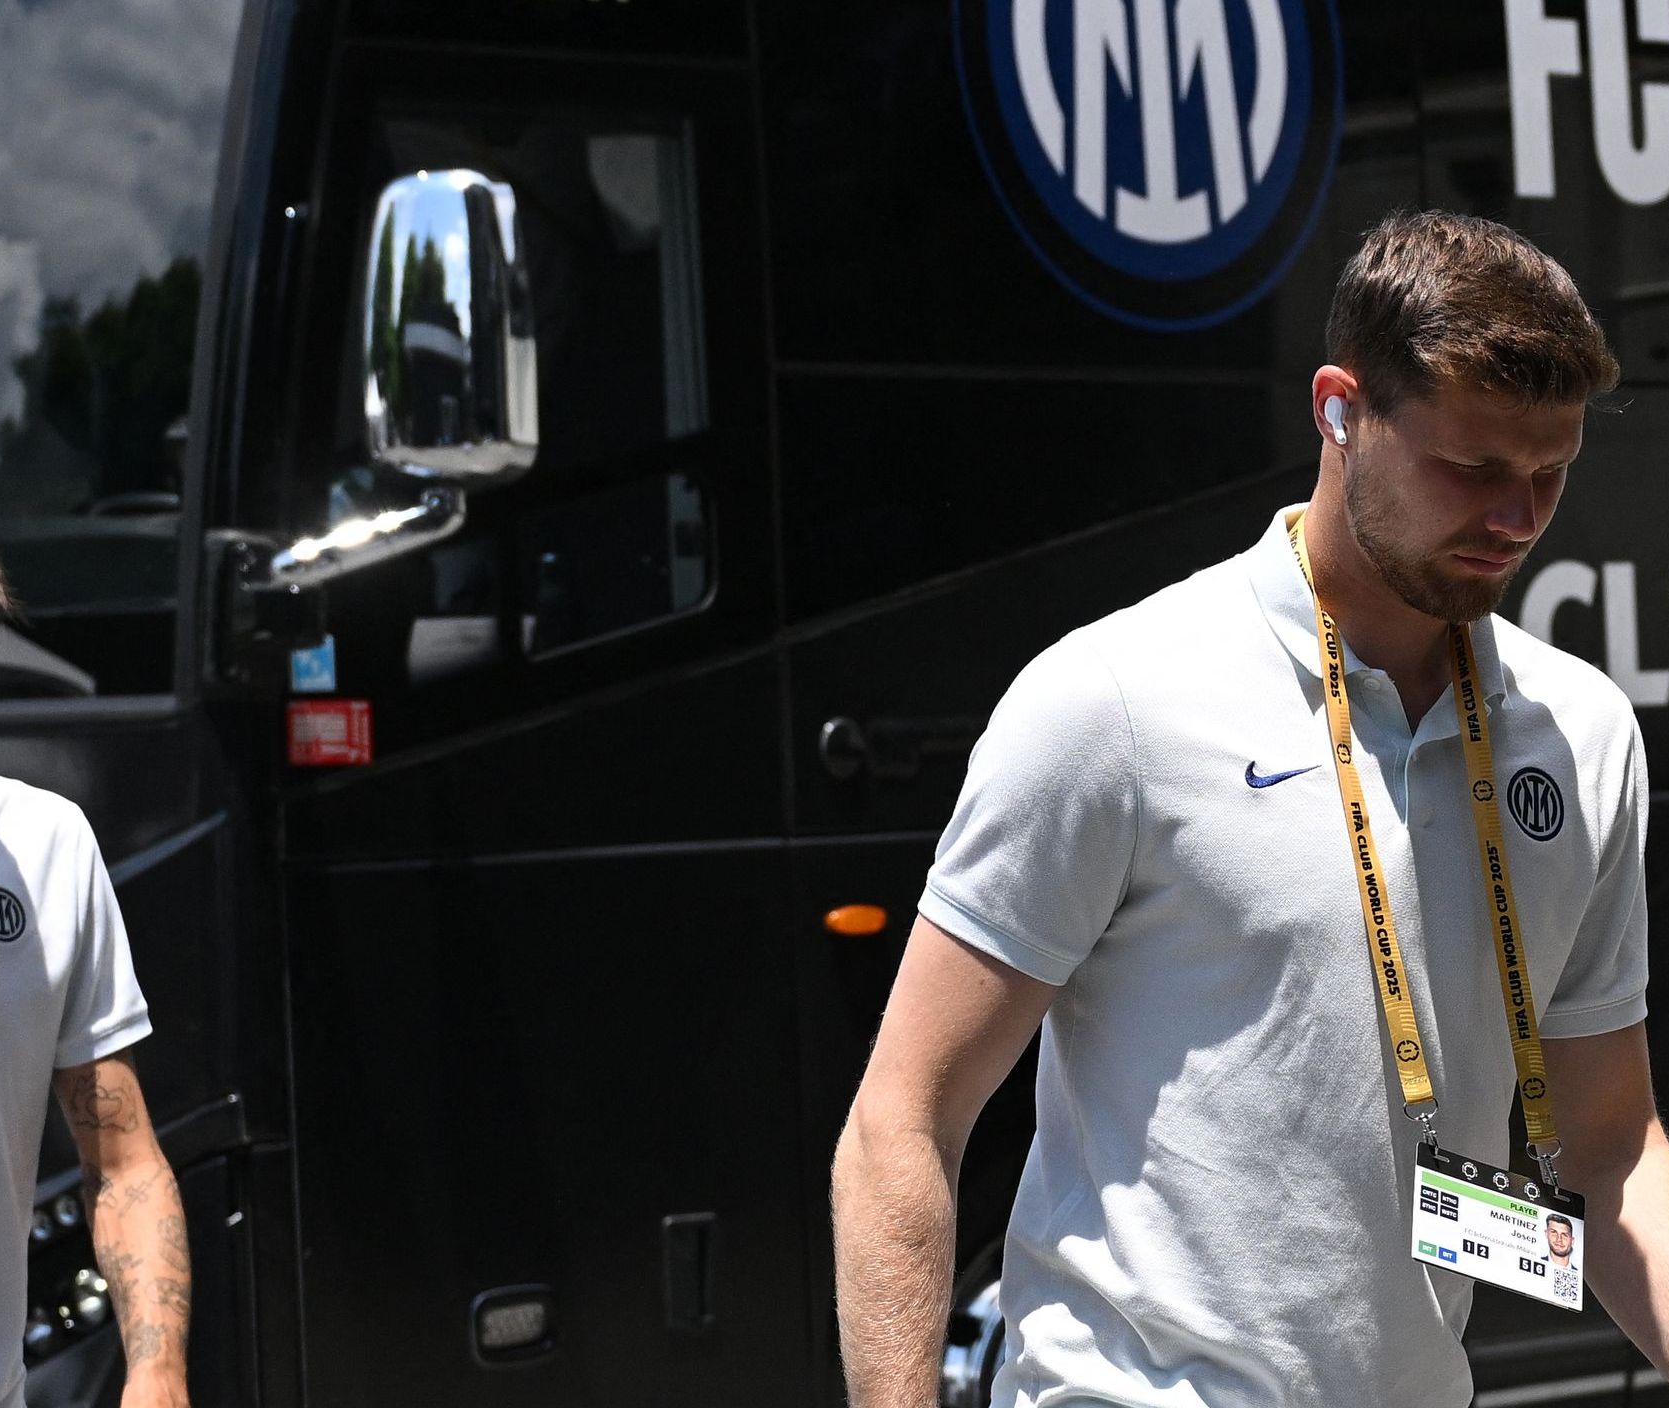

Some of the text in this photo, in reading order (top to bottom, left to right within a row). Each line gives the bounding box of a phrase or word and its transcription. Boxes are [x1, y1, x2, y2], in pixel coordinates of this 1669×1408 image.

[1325, 633, 1338, 660] CUP
[1461, 679, 1476, 712] CLUB
[1467, 713, 1481, 743] FIFA
[1350, 802, 1365, 833] FIFA
[1356, 834, 1373, 872] CLUB
[1364, 872, 1385, 927] WORLD
[1494, 883, 1509, 913] CUP
[1376, 928, 1392, 958] CUP
[1500, 914, 1520, 968] WORLD
[1506, 970, 1525, 1007] CLUB
[1517, 1008, 1531, 1040] FIFA
[1490, 1210, 1538, 1232] MARTINEZ
[1510, 1202, 1538, 1218] PLAYER
[1510, 1229, 1537, 1244] Josep
